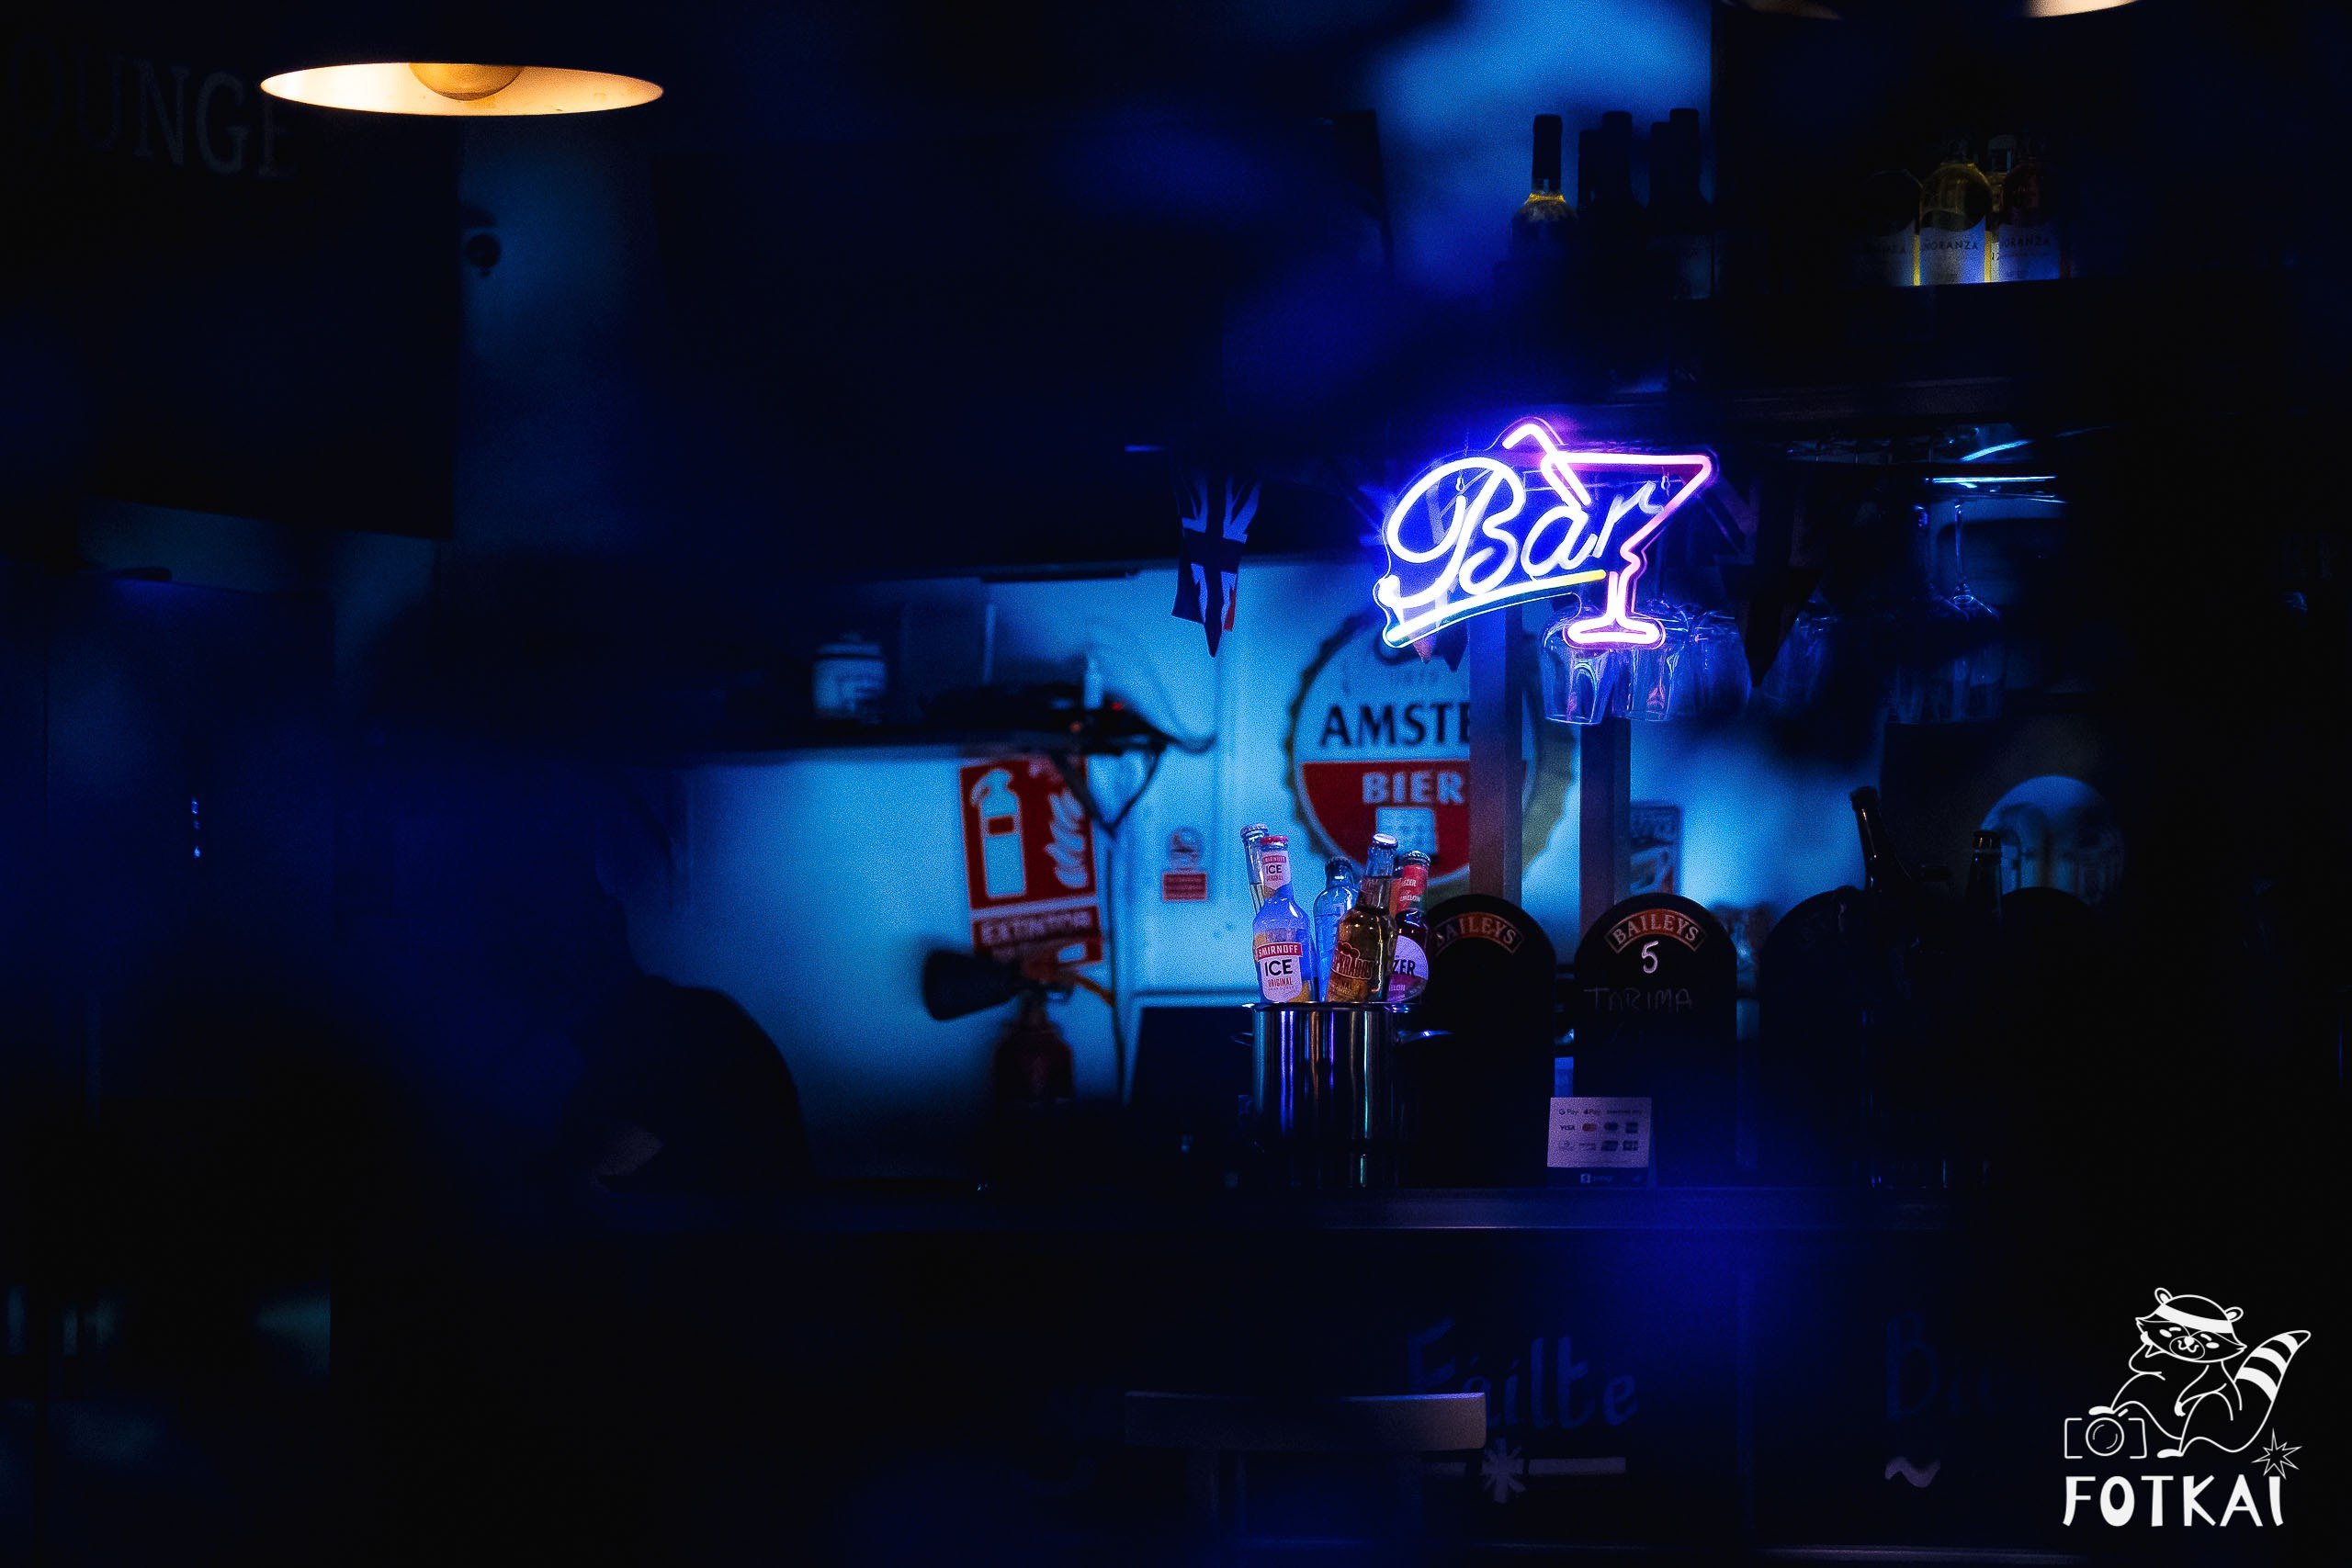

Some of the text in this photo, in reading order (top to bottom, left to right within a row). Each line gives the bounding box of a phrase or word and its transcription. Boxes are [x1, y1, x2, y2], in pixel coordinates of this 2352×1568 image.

[1378, 456, 1666, 610] Bar
[1362, 770, 1464, 806] BIER
[1266, 864, 1283, 874] ICE
[1611, 913, 1699, 946] BAILEYS
[1258, 944, 1298, 958] SMIRNOFF
[1641, 940, 1659, 974] 5
[1264, 959, 1294, 977] ICE
